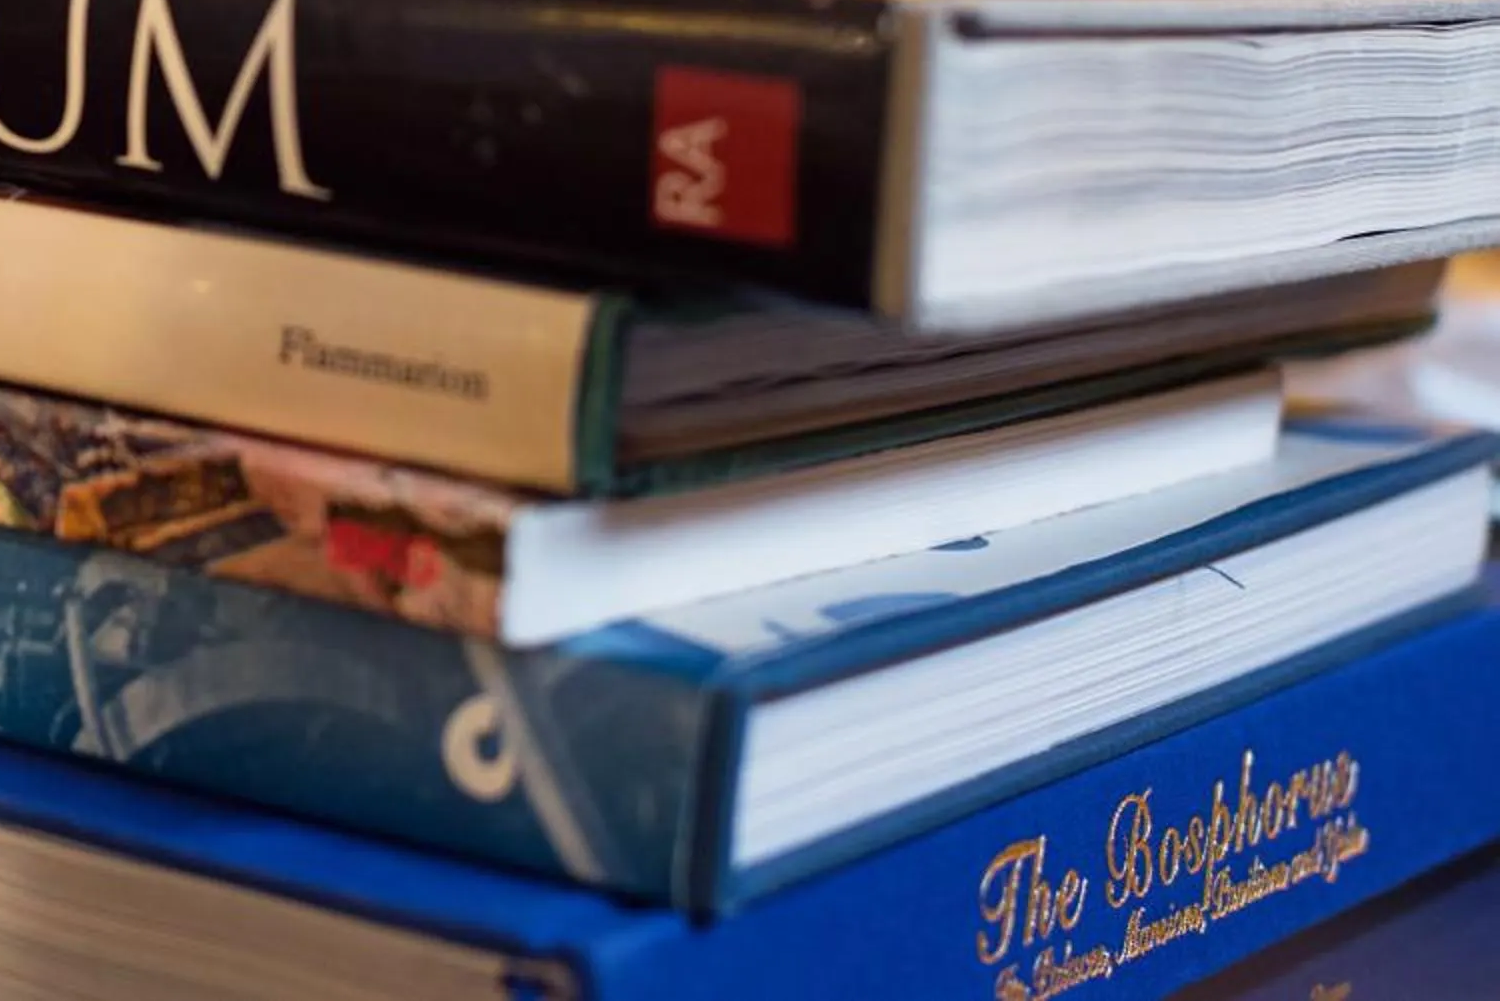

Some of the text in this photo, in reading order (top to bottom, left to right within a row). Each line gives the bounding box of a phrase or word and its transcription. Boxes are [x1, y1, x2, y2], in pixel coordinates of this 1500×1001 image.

[655, 116, 728, 226] RA
[977, 835, 1088, 964] The
[1106, 749, 1359, 909] Bosphorus
